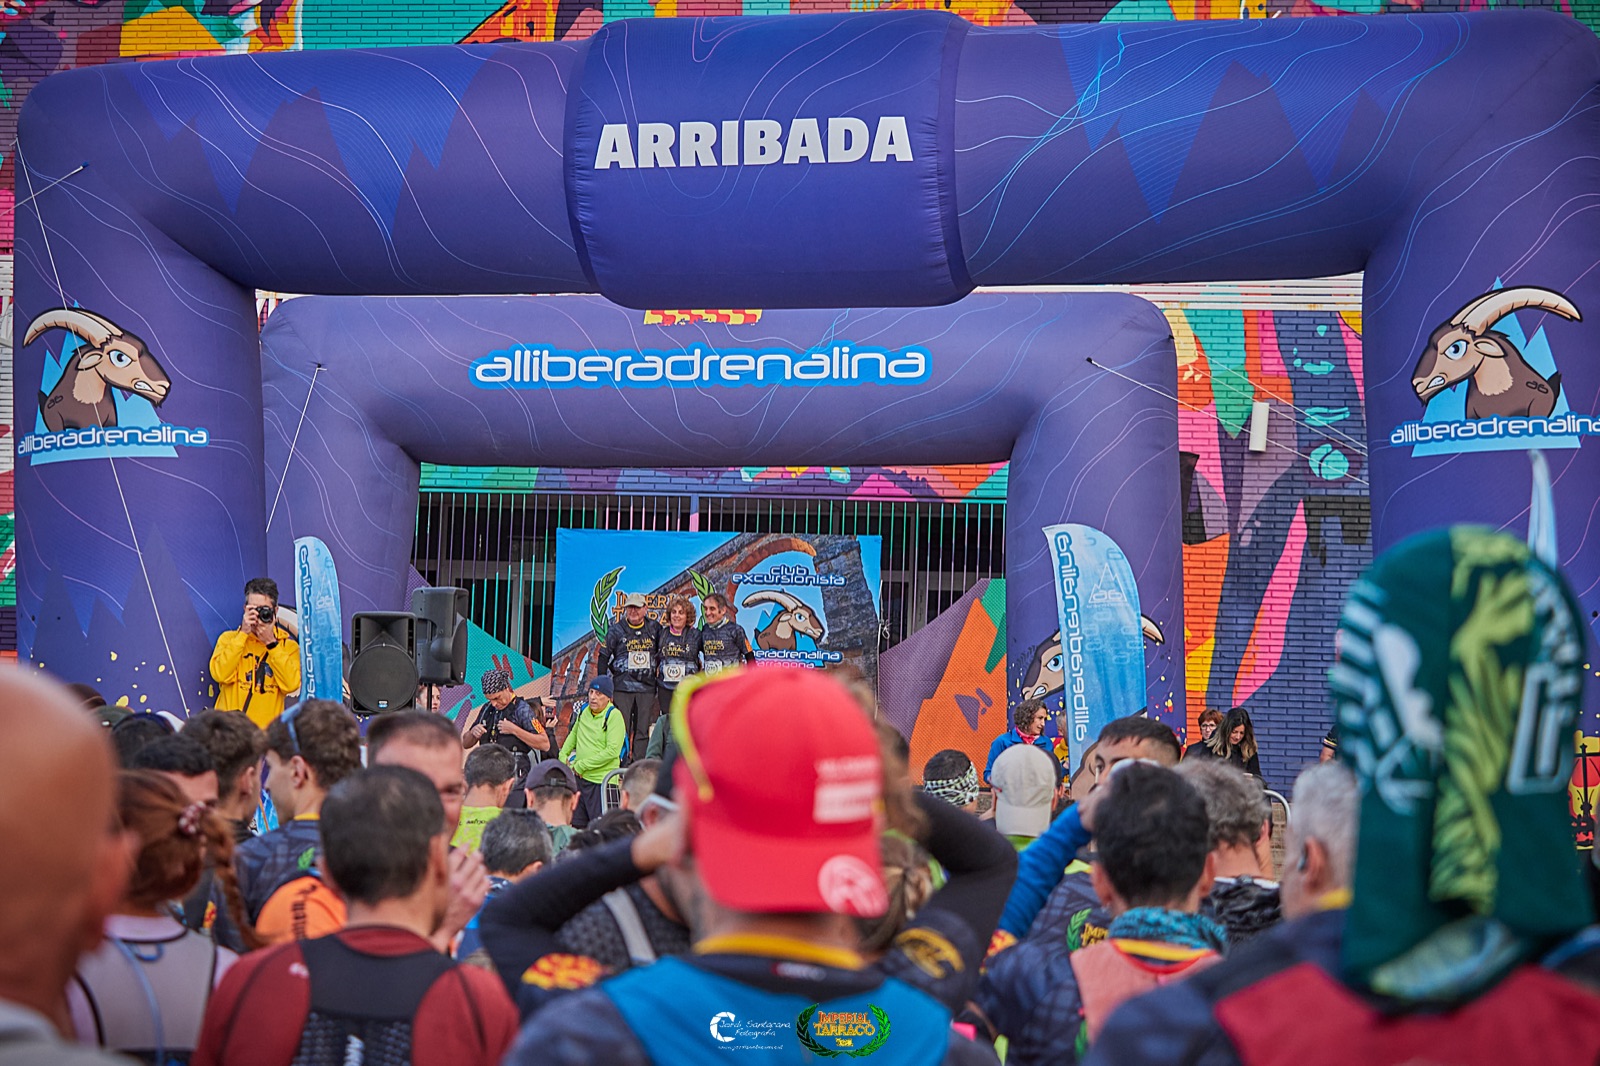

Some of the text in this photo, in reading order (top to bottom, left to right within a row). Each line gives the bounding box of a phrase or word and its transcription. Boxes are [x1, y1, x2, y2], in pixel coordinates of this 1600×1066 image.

[594, 116, 914, 170] ARRIBADA
[475, 346, 926, 384] alliberadrenalina
[17, 426, 207, 455] alliberadrenalina
[732, 573, 846, 586] excursionista
[770, 565, 808, 576] club
